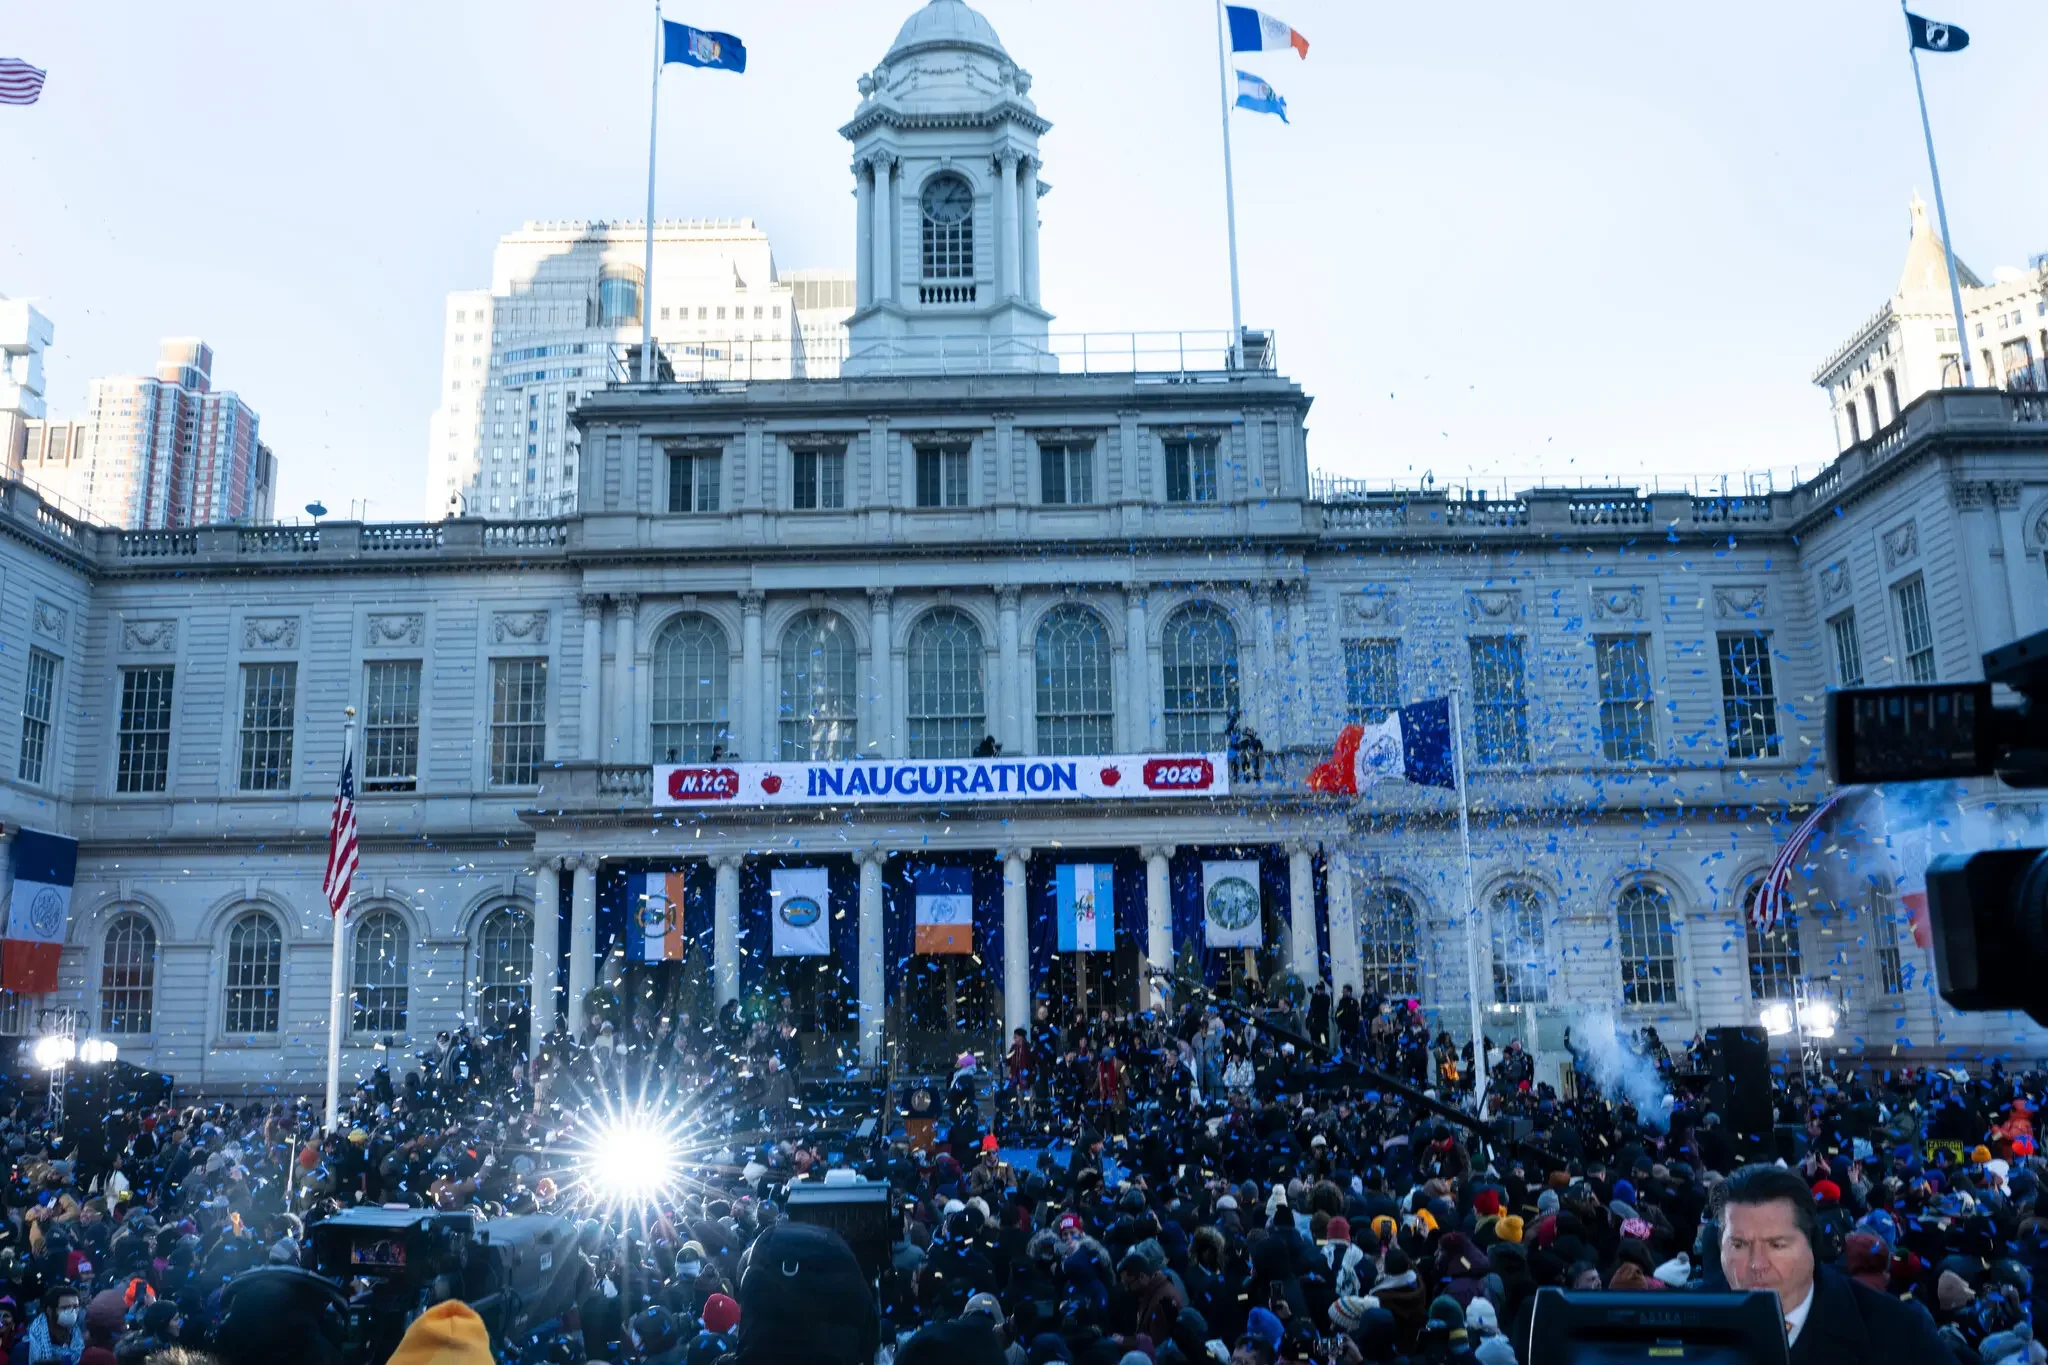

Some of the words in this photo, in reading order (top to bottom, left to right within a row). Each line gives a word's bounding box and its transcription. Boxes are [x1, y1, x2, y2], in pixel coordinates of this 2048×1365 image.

[680, 774, 729, 792] N.Y.C.
[806, 763, 1077, 796] INAUGURATION
[1154, 765, 1203, 784] 2026
